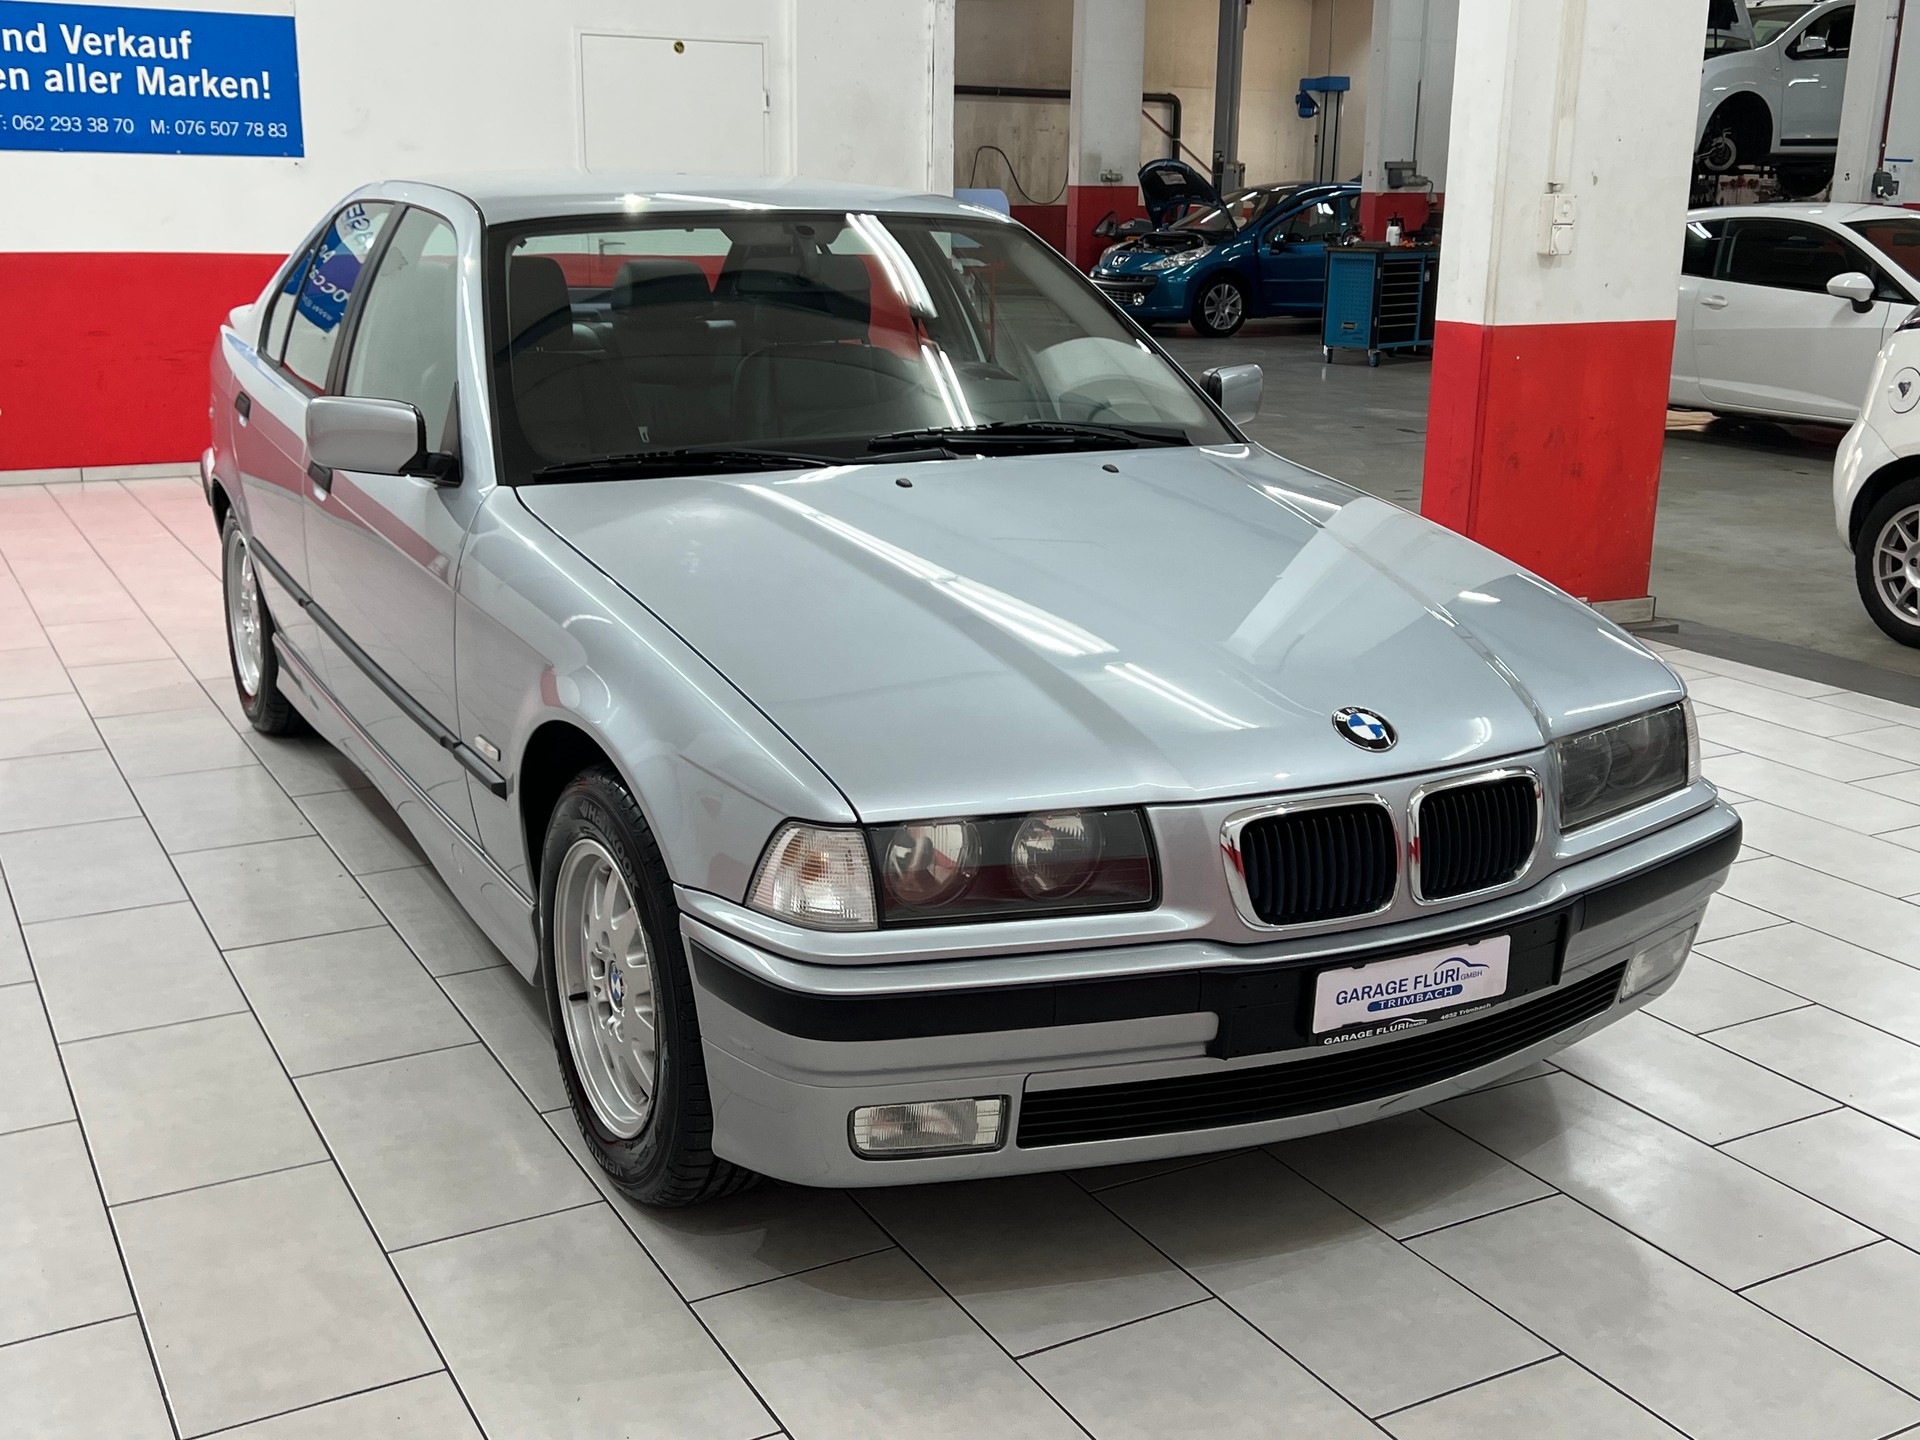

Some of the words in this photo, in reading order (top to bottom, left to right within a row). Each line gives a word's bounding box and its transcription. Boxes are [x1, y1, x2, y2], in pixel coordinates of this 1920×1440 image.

[2, 22, 47, 53] nd
[59, 24, 192, 60] Verkauf
[44, 62, 122, 94] aller
[136, 65, 271, 99] Marken!
[12, 114, 45, 131] 062
[49, 116, 82, 132] 293
[87, 117, 108, 133] 38
[112, 117, 134, 134] 70
[150, 119, 170, 135] M:
[175, 119, 206, 135] 076
[210, 121, 239, 136] 507
[244, 121, 264, 137] 78
[268, 122, 288, 138] 83
[1335, 978, 1409, 1006] GARAGE
[1413, 967, 1460, 991] FLURI
[1378, 987, 1453, 1009] TRIMBACH
[1323, 1029, 1373, 1045] GARAGE
[1376, 1021, 1410, 1035] FLURI
